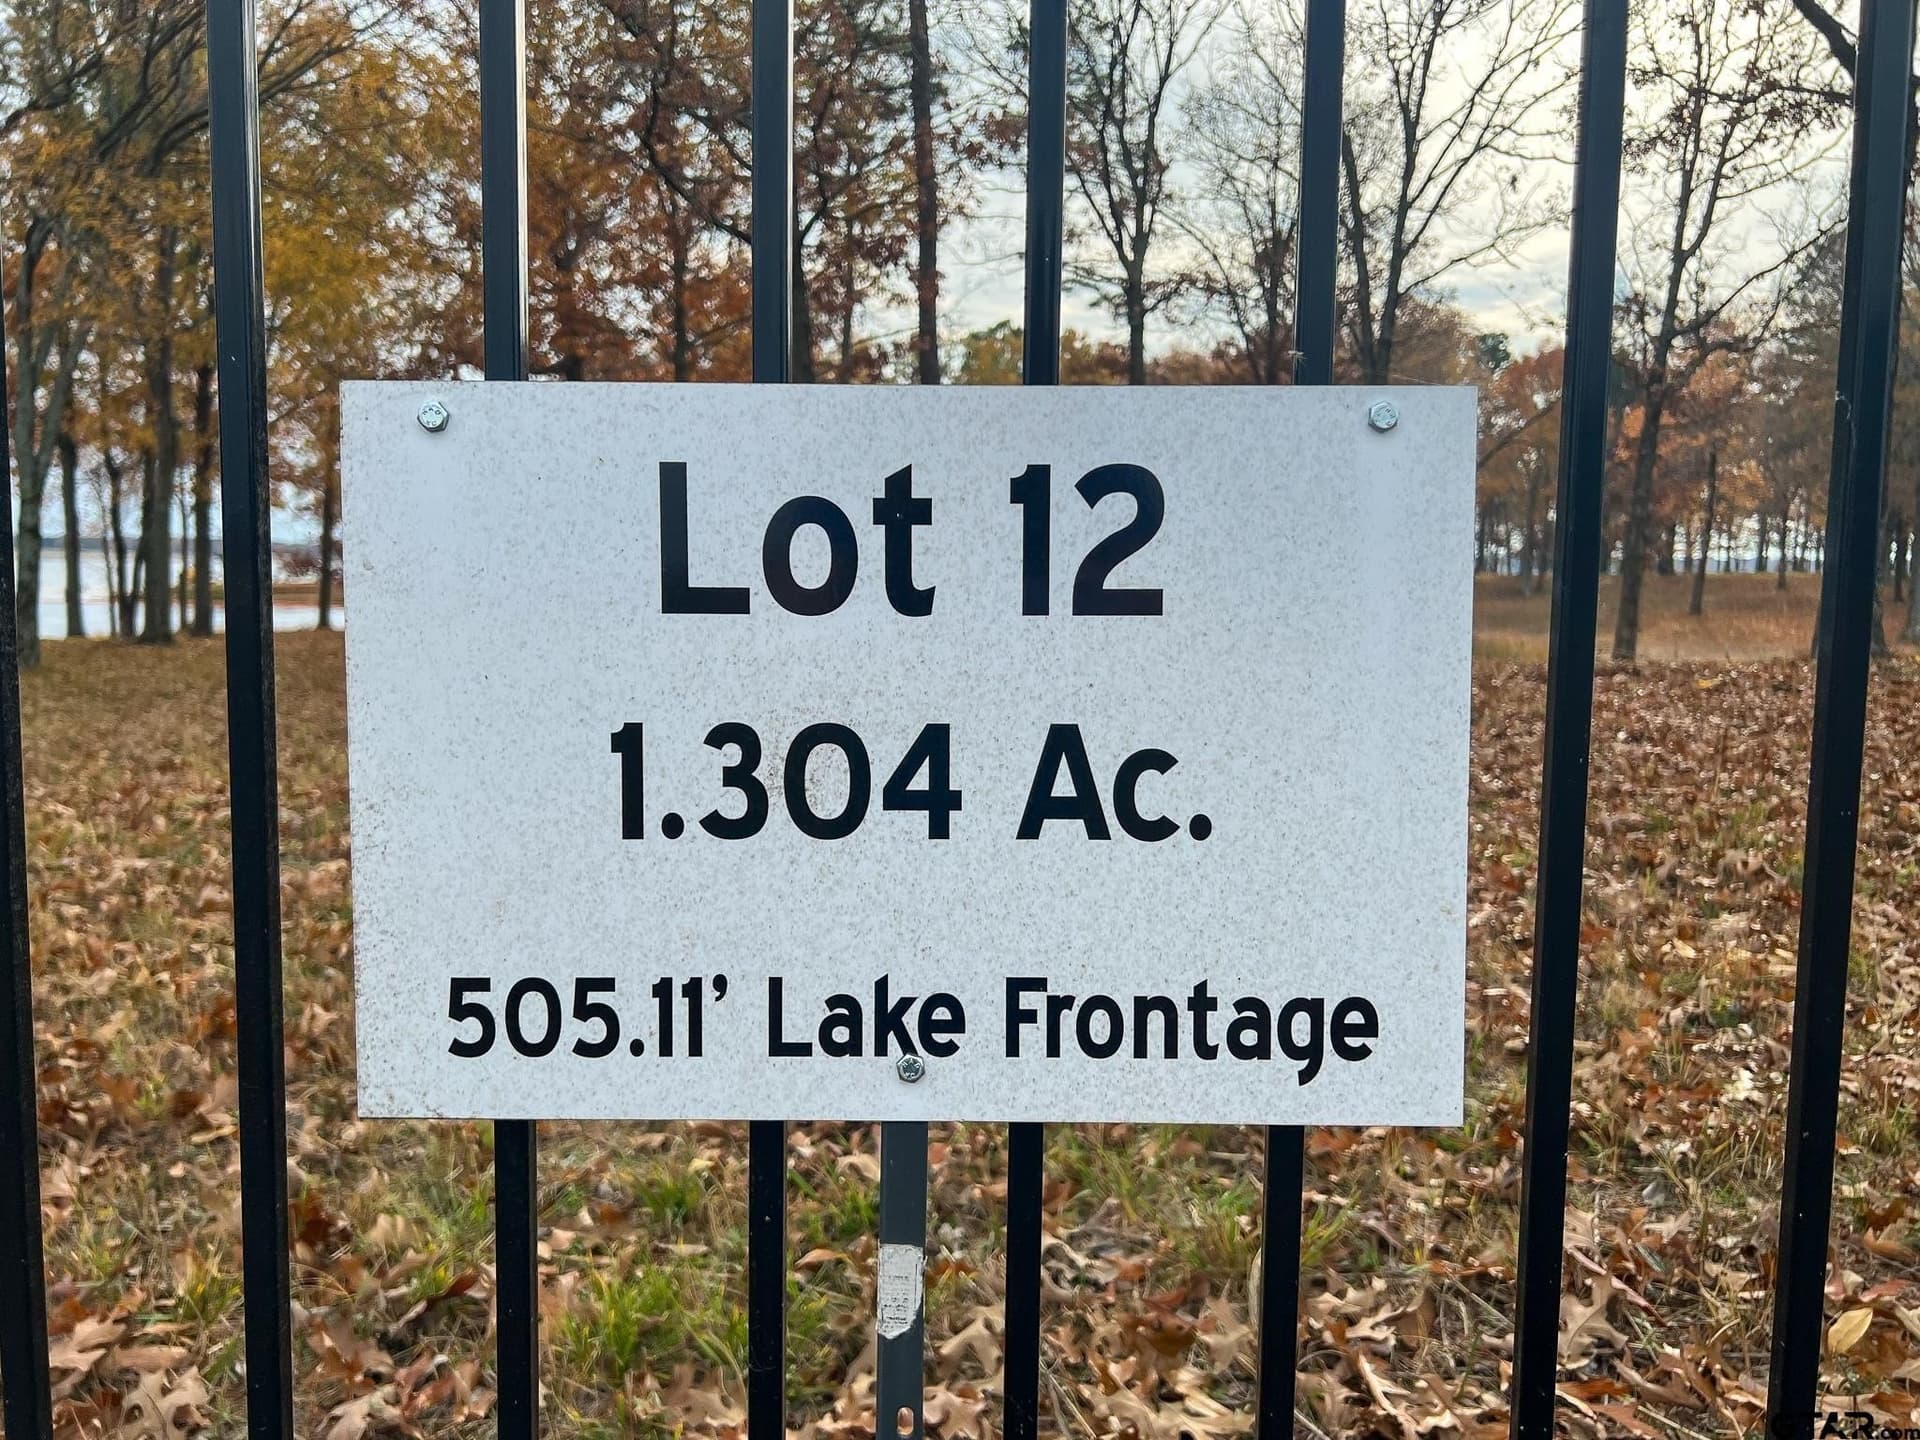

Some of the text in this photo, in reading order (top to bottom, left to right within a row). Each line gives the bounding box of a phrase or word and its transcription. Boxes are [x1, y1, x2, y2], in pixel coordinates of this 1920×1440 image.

[658, 461, 1165, 618] Lot 12
[610, 721, 1213, 843] 1.304 Ac.
[447, 976, 1379, 1087] 505.11' Lake Frontage
